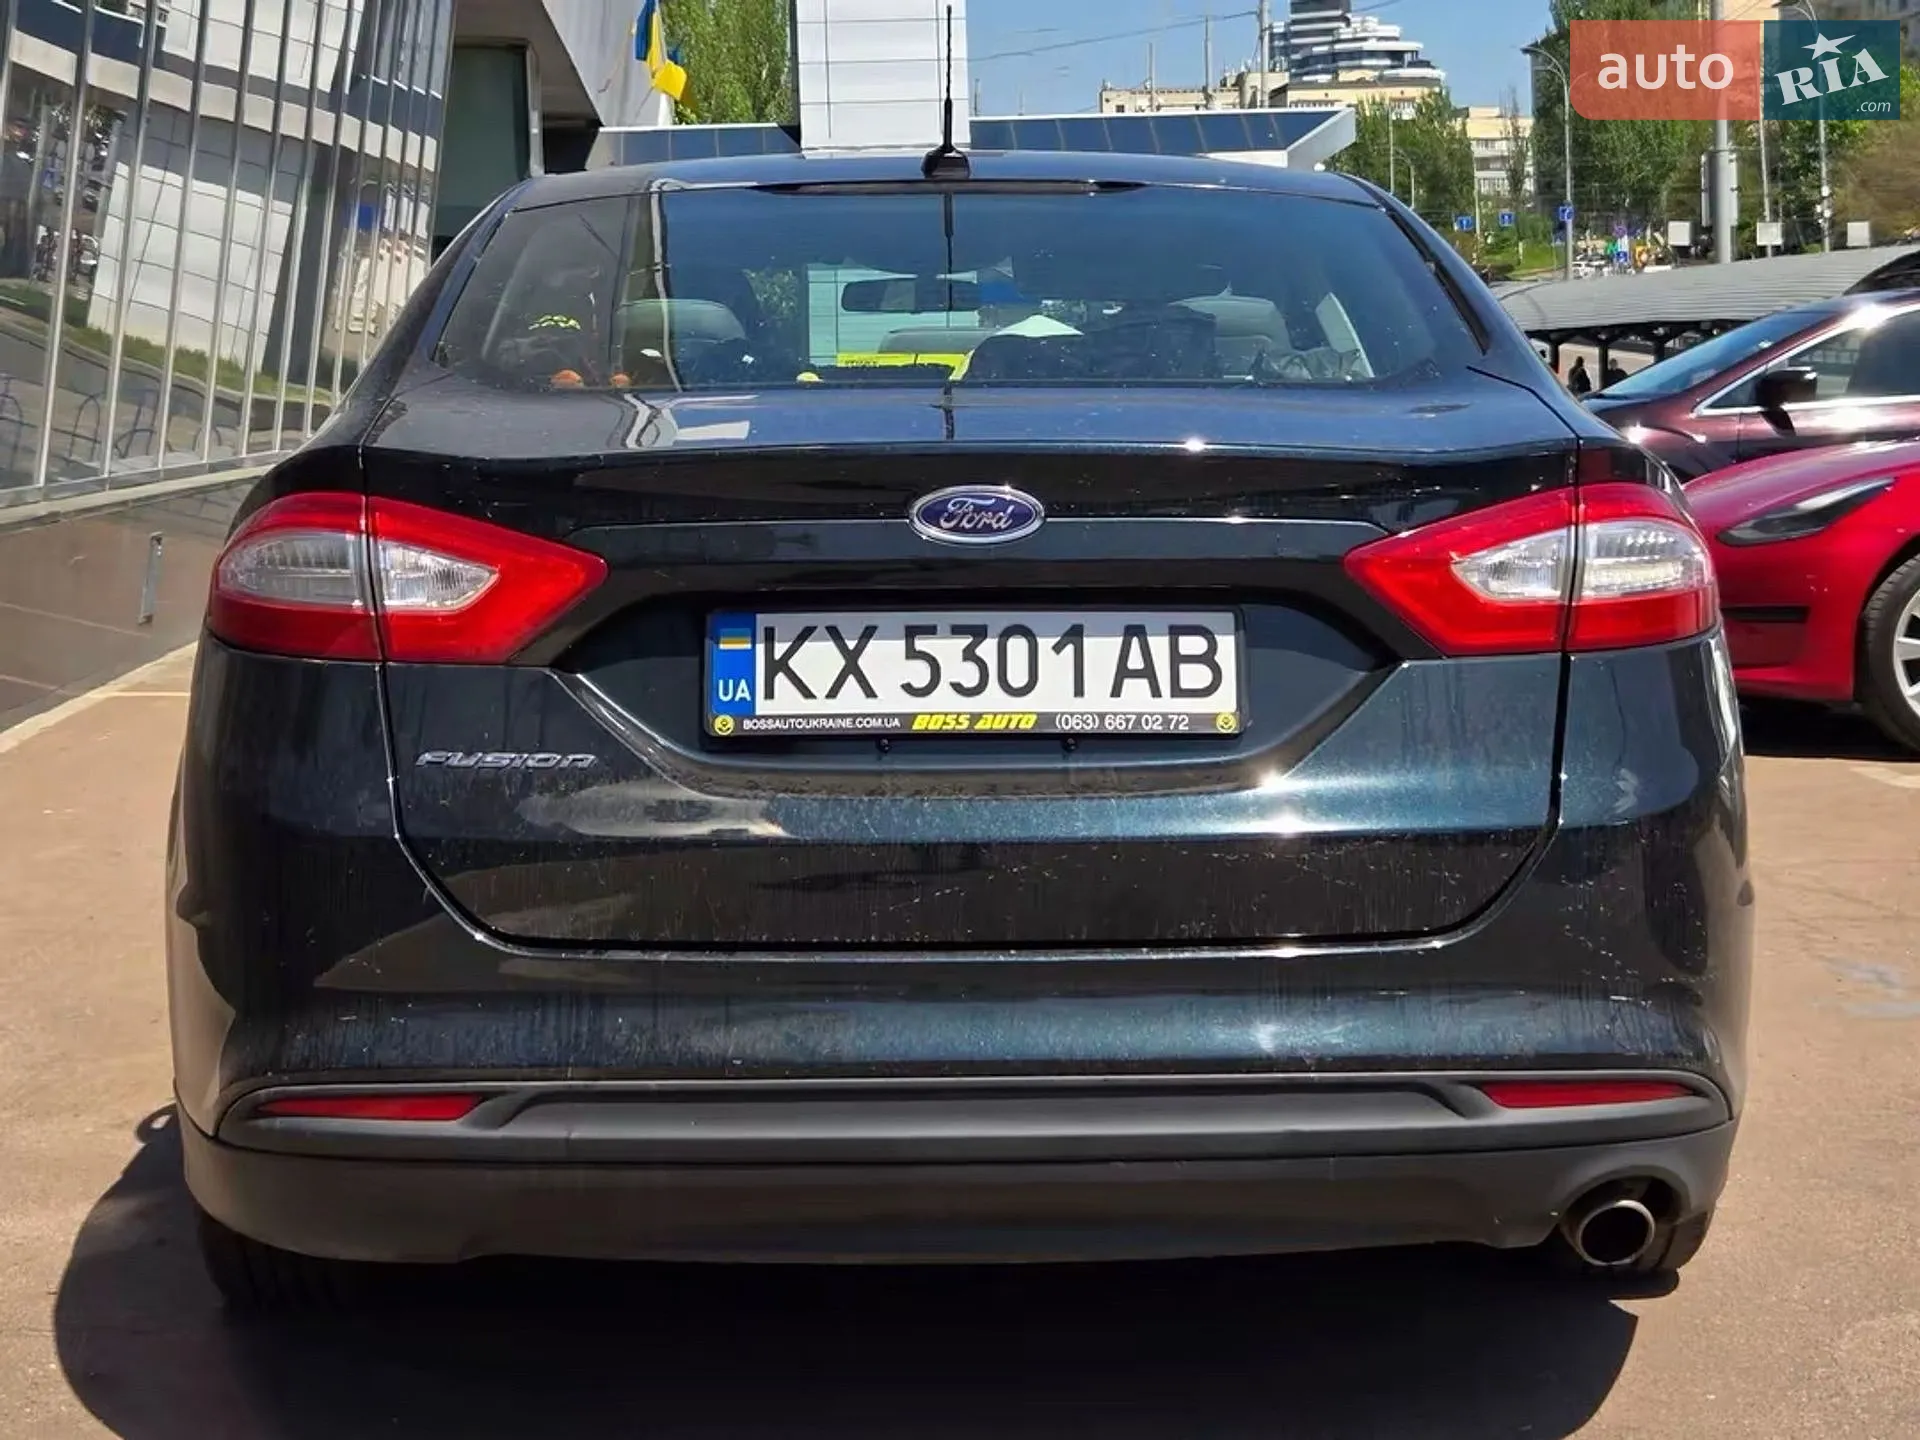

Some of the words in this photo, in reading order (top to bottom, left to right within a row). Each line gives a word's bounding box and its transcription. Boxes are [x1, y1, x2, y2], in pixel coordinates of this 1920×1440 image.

[940, 497, 1015, 529] Ford
[763, 624, 879, 701] KX
[900, 623, 1086, 699] 5301
[1109, 624, 1223, 699] AB
[717, 678, 751, 702] UA
[742, 716, 901, 731] BOSSAUTOUKRAINE.COM.UA
[912, 713, 970, 731] BOSS
[974, 713, 1037, 731] AUTO
[1055, 714, 1099, 731] (063)
[1104, 714, 1136, 730] 667
[1142, 714, 1164, 730] 02
[1167, 714, 1190, 730] 72
